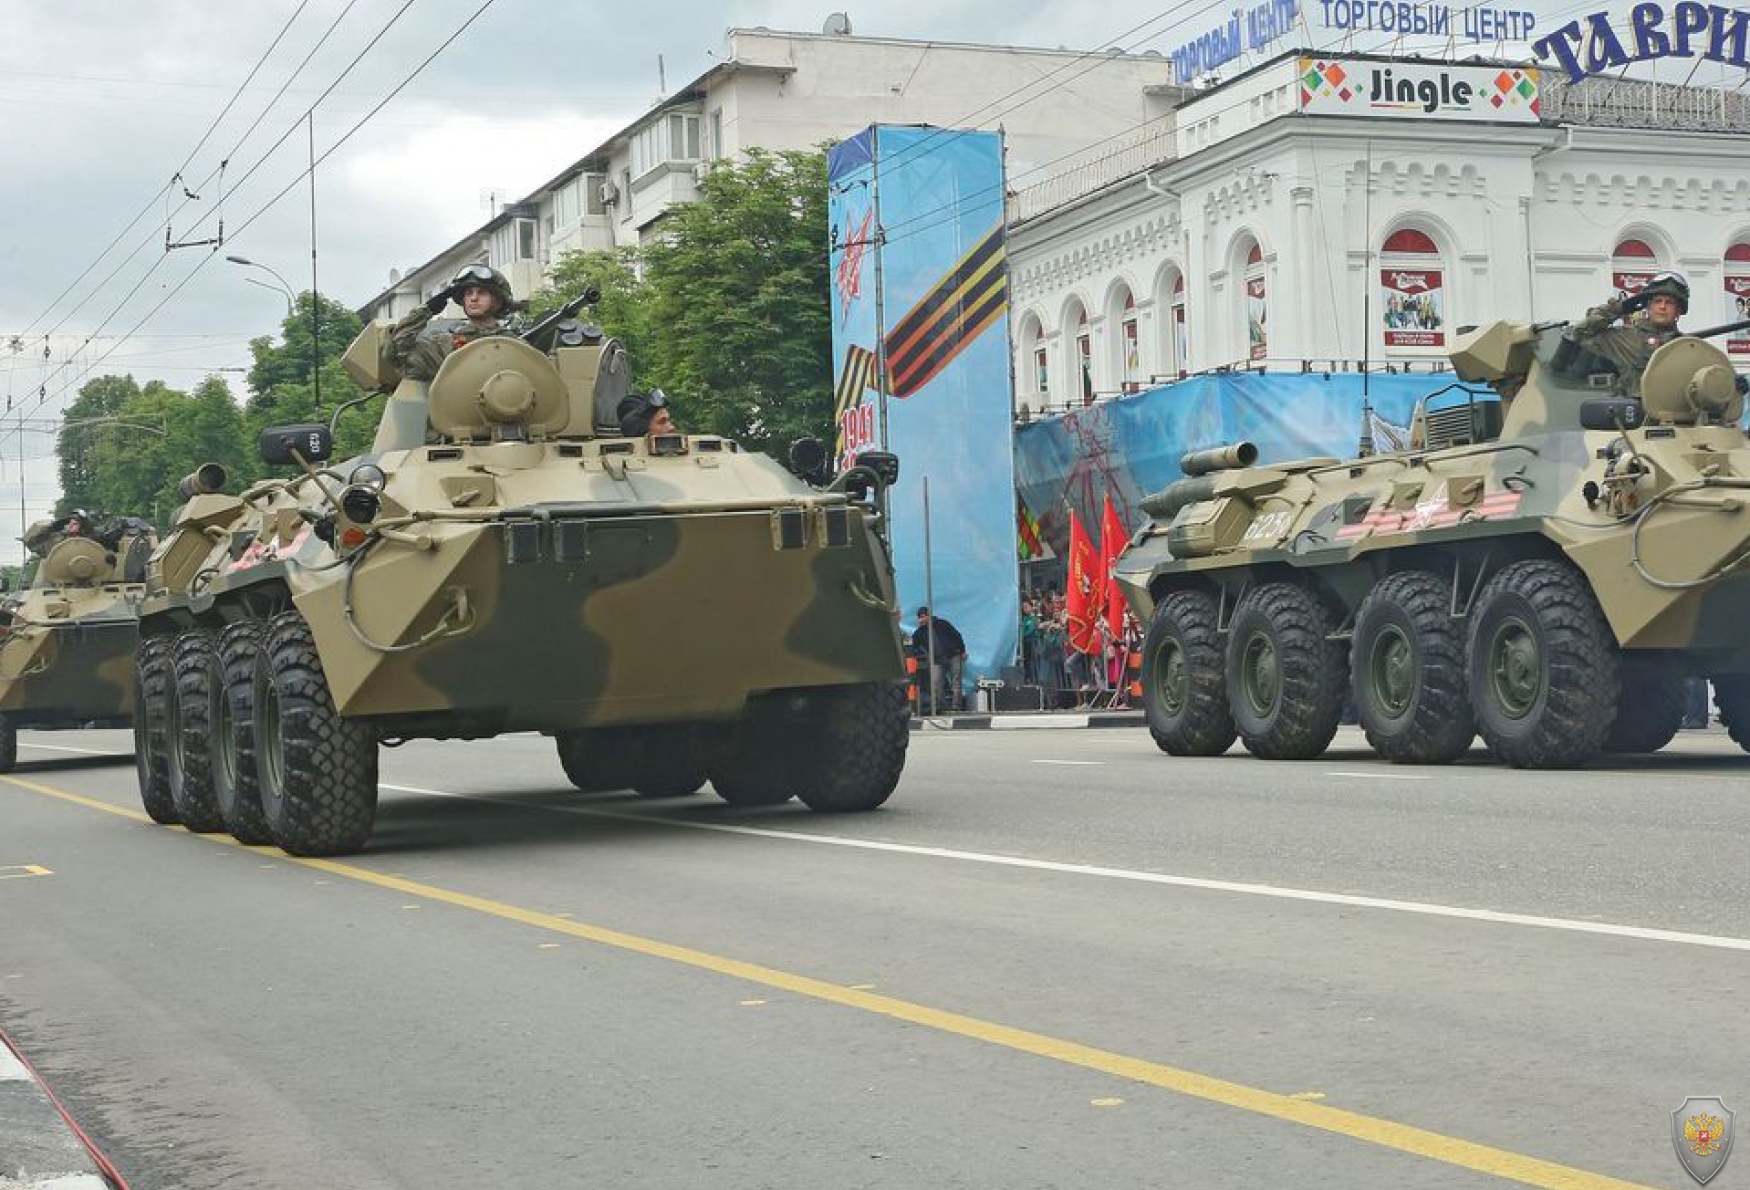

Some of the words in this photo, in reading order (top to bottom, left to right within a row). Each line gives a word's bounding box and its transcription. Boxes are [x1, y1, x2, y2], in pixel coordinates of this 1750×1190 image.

[1171, 8, 1242, 84] ТОРГОВЫЙ
[1465, 8, 1535, 43] ЦЕНТР
[1370, 69, 1473, 113] Jingle
[842, 403, 873, 450] 1941
